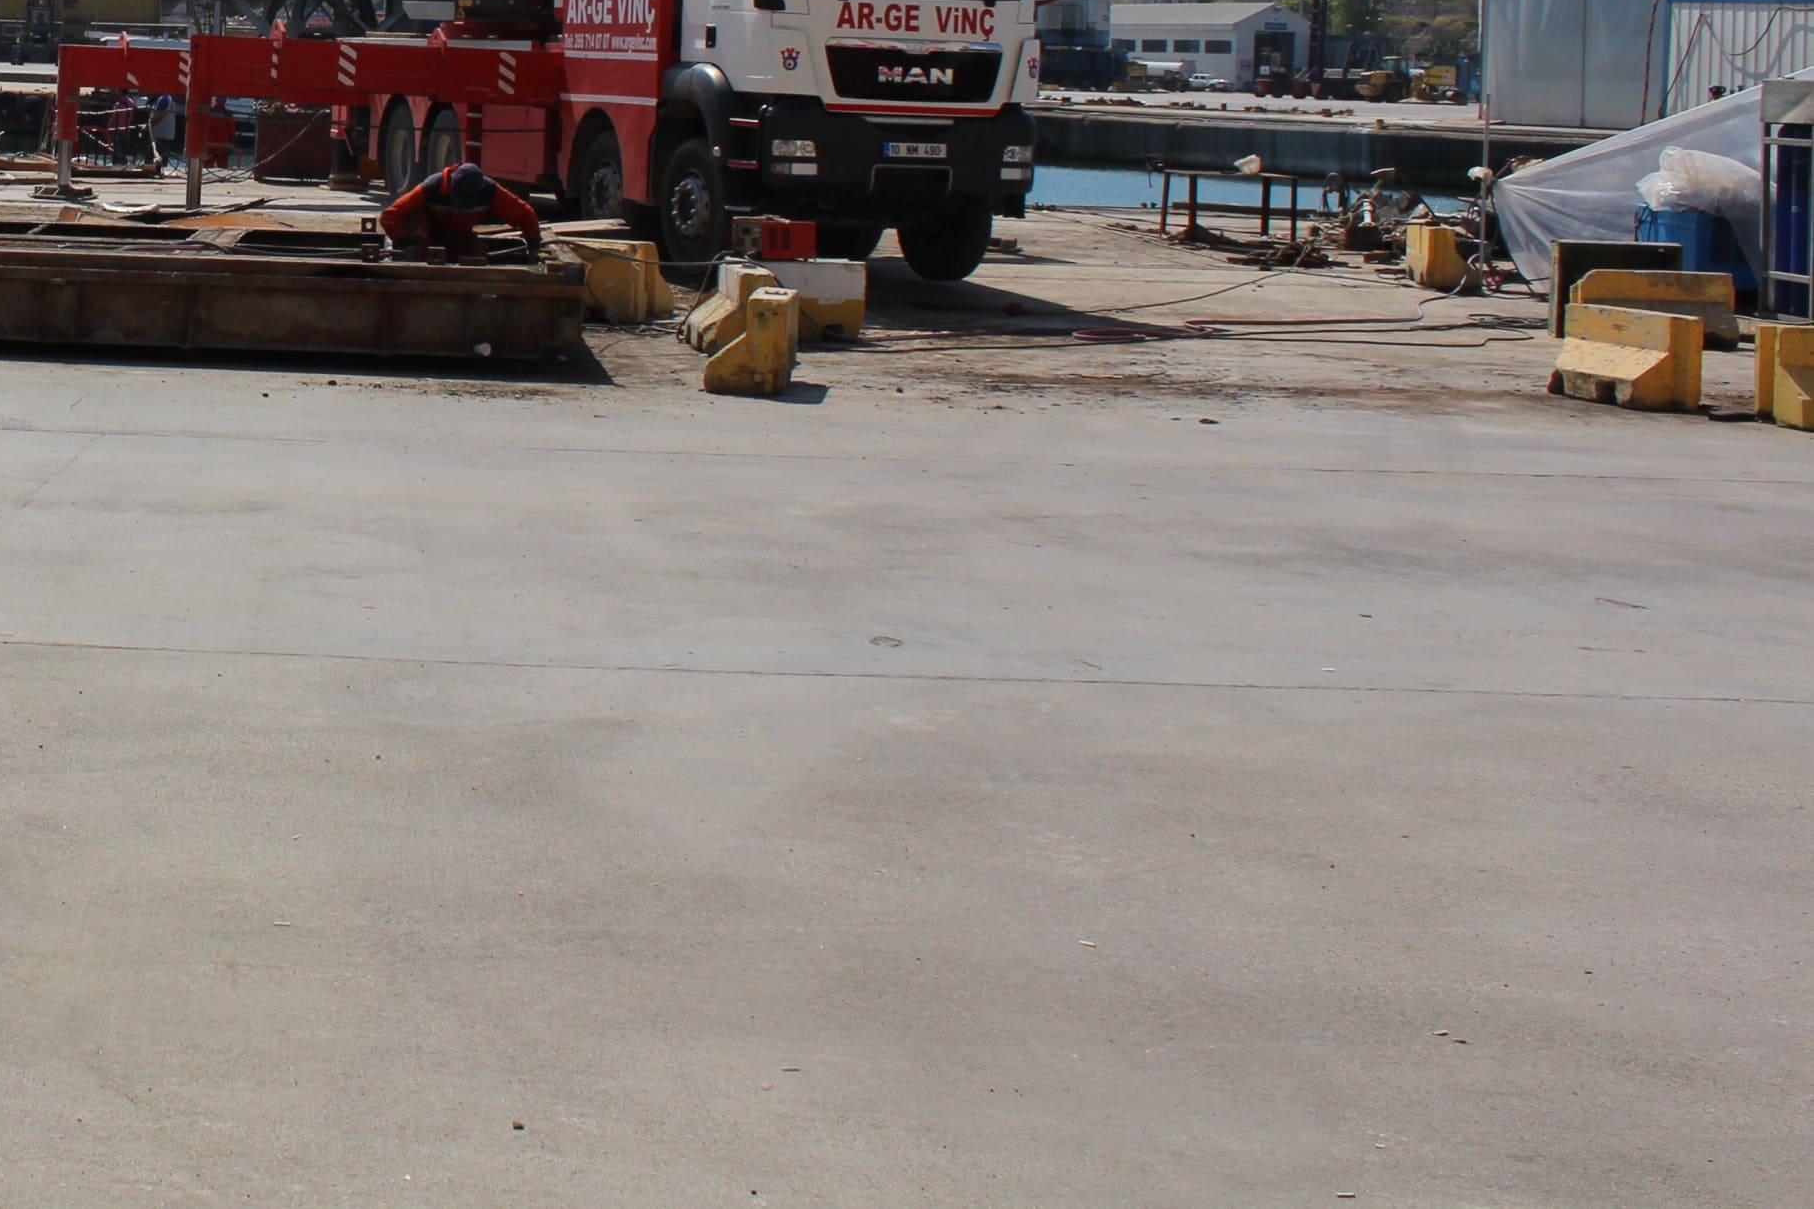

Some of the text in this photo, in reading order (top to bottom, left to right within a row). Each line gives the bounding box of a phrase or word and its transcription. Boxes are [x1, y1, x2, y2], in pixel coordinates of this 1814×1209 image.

[836, 1, 921, 32] AR-GE
[878, 66, 954, 85] MAN
[891, 144, 900, 155] 10
